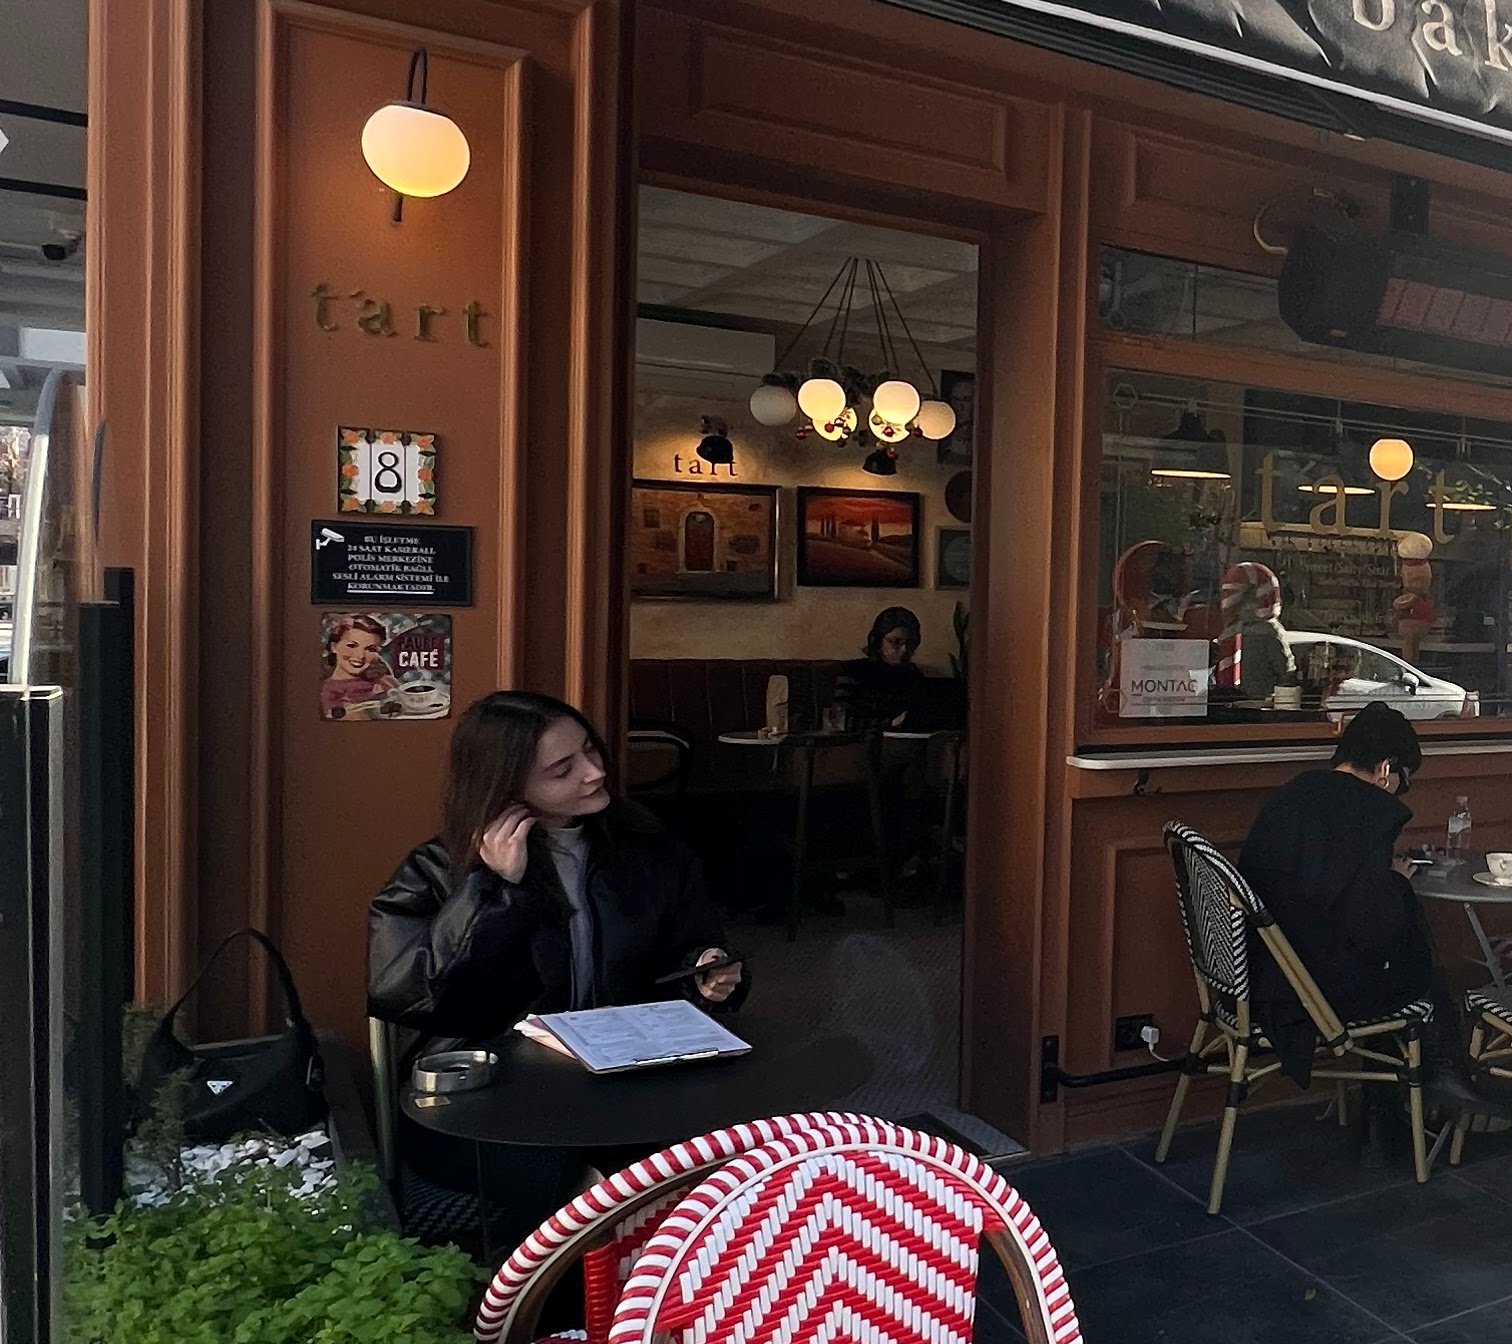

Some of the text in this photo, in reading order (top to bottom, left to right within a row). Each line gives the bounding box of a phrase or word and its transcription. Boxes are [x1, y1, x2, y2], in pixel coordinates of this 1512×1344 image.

[374, 451, 402, 493] 8
[358, 545, 382, 553] SAAT
[347, 554, 434, 563] POLİS MERKEZİNE
[348, 563, 402, 571] OTOMATİK
[360, 573, 393, 581] ALARM
[398, 648, 439, 668] CAFÉ
